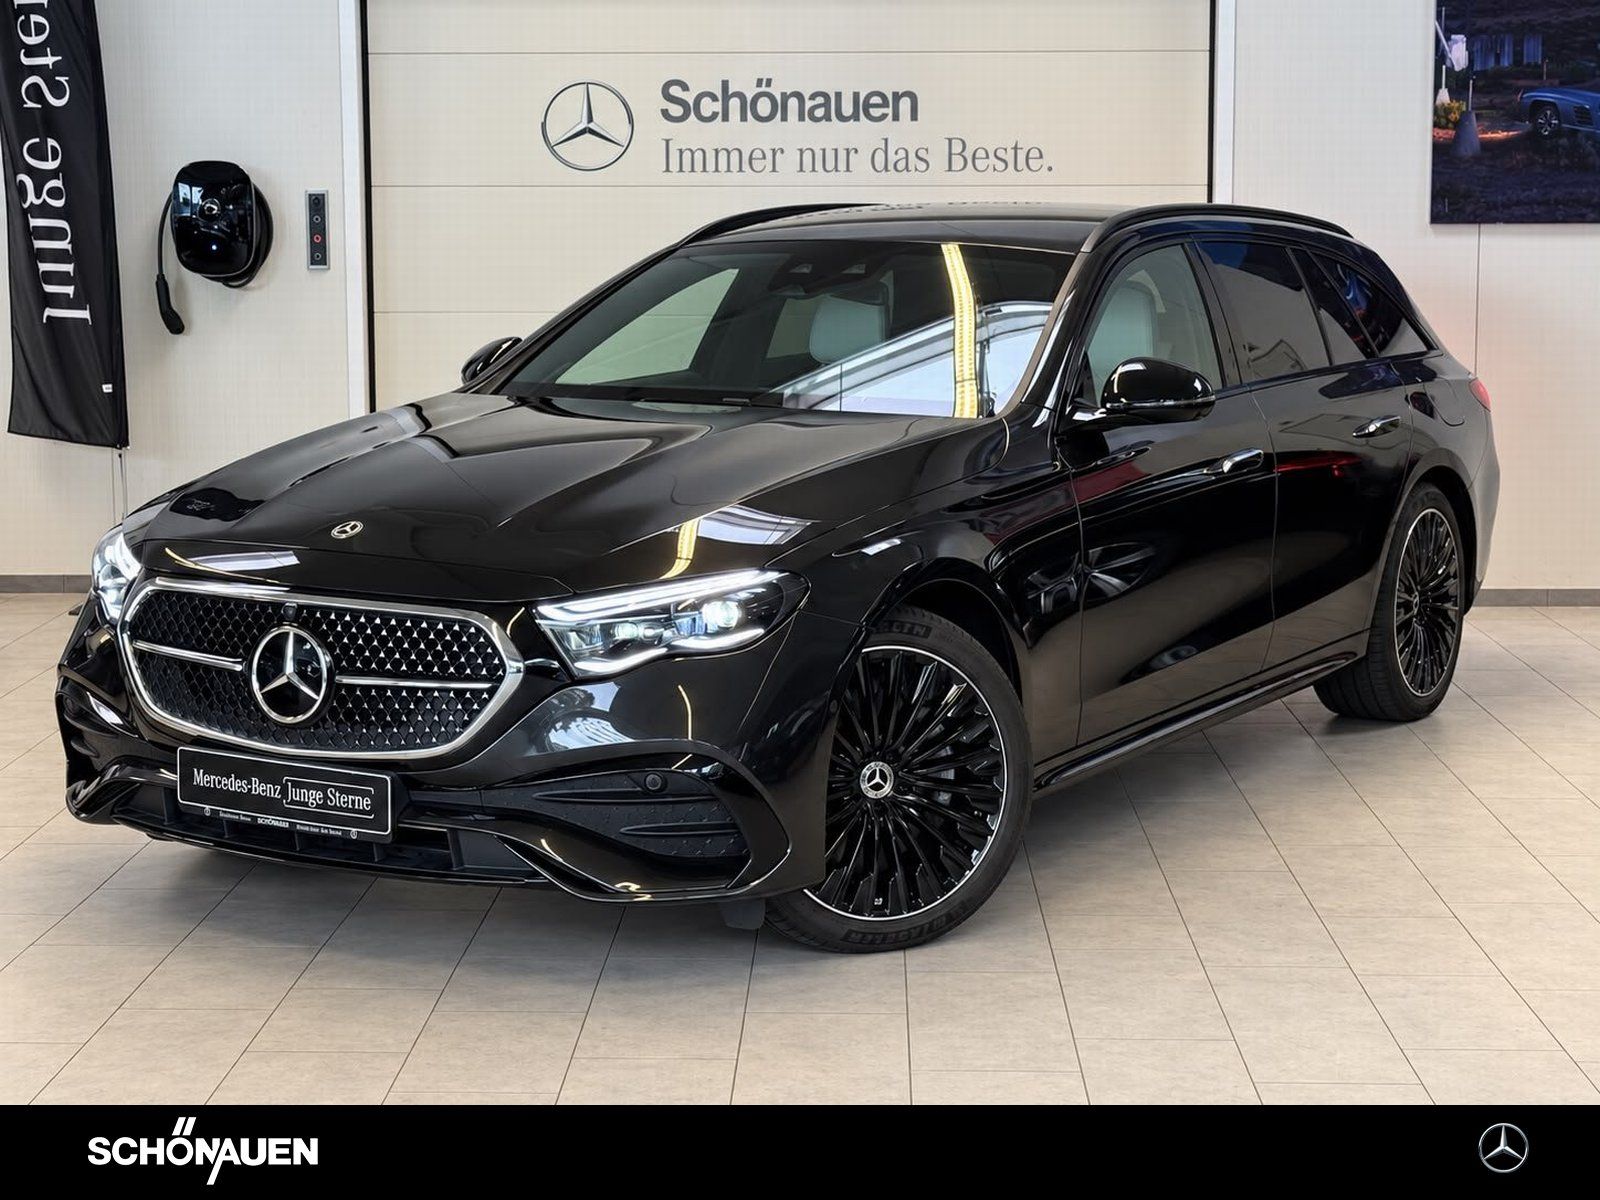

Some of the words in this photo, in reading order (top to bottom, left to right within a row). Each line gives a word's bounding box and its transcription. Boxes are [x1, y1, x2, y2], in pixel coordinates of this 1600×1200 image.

[660, 78, 919, 124] Schönauen
[662, 138, 785, 174] Immer
[796, 146, 859, 174] nur
[870, 137, 930, 174] das
[944, 137, 1054, 174] Beste.
[193, 768, 281, 799] Mercedes-Benz
[287, 782, 323, 808] Junge
[327, 788, 371, 811] Sterne
